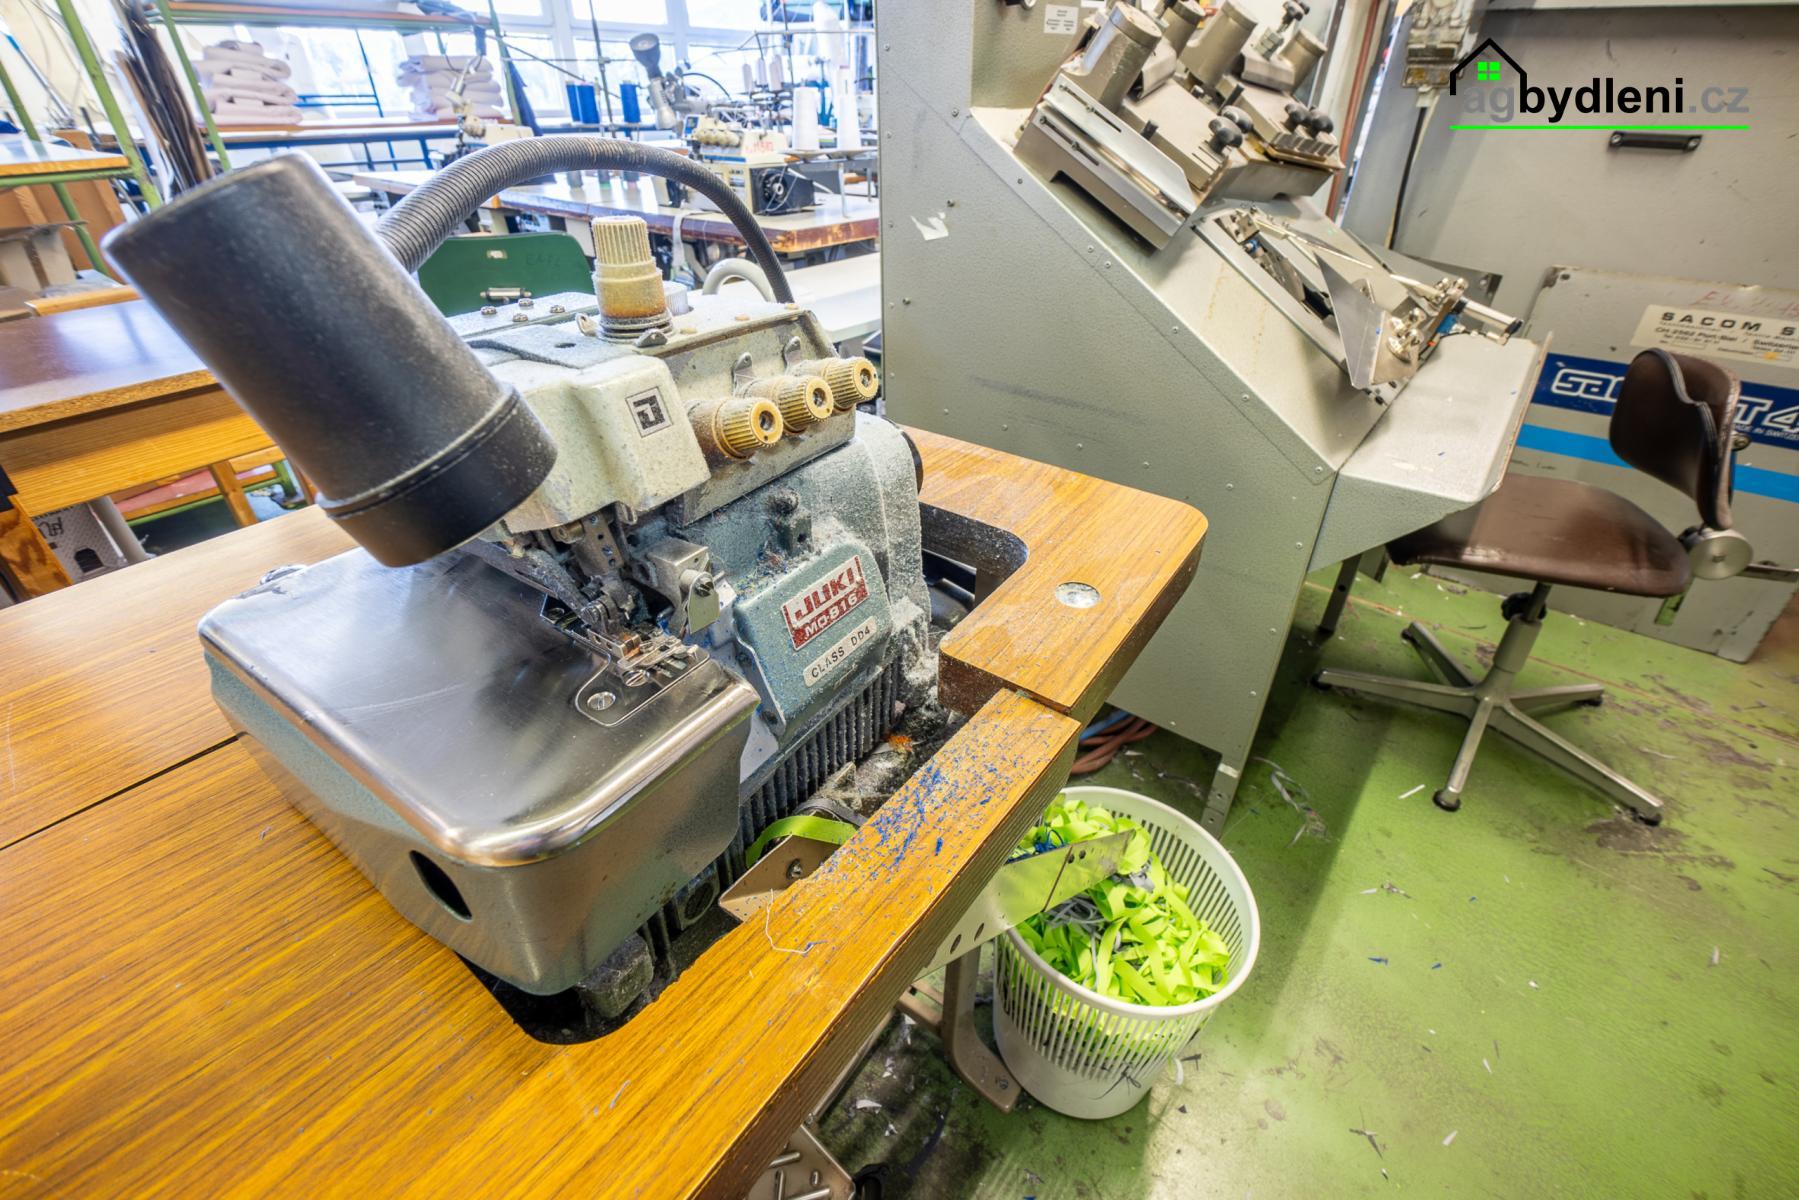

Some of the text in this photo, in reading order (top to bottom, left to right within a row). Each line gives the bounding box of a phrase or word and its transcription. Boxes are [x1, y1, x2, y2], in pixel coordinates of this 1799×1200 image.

[1661, 312, 1761, 331] SACOM
[795, 567, 854, 620] JUKI
[811, 625, 871, 678] CLASS DD4
